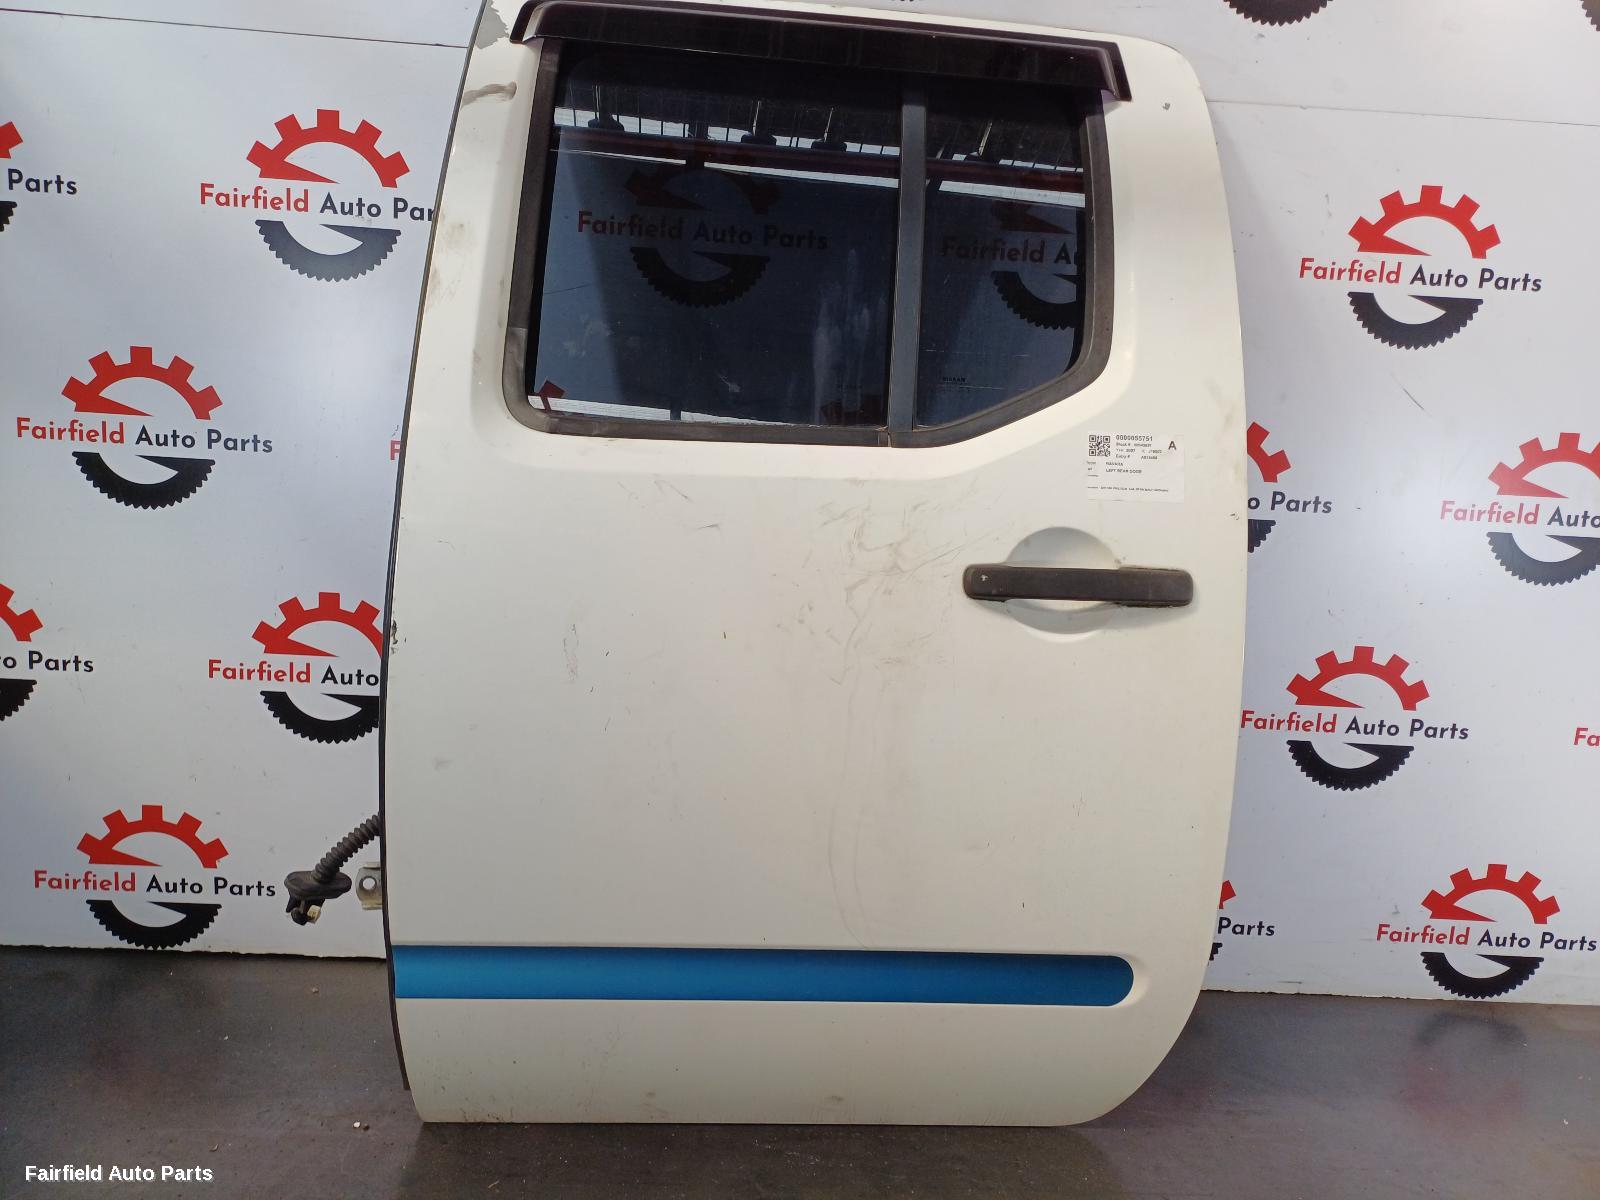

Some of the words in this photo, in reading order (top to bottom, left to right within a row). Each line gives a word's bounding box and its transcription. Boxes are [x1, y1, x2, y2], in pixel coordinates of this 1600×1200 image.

[8, 169, 77, 195] Parts
[201, 183, 309, 212] Fairfield
[320, 192, 381, 217] Auto
[393, 197, 434, 222] Par
[578, 210, 682, 241] Fairfield
[693, 217, 752, 246] Auto
[763, 224, 828, 251] Parts
[941, 236, 1045, 263] Fairfield
[1300, 258, 1401, 283] Fairfield
[1410, 264, 1468, 287] Auto
[1479, 268, 1541, 291] Parts
[17, 417, 125, 444] Fairfield
[135, 425, 195, 448] Auto
[207, 429, 272, 453] Parts
[1168, 440, 1177, 450] A
[1271, 491, 1331, 513] Parts
[1441, 501, 1540, 524] Fairfield
[1547, 506, 1600, 528] Auto
[29, 650, 93, 672] Parts
[209, 659, 311, 683] Fairfield
[321, 665, 379, 686] Auto
[1241, 710, 1337, 733] Fairfield
[1345, 716, 1399, 736] Auto
[1410, 719, 1468, 739] Parts
[35, 870, 136, 891] Fairfield
[146, 874, 203, 893] Auto
[214, 877, 275, 896] Parts
[1218, 917, 1274, 936] Parts
[1377, 924, 1470, 945] Fairfield
[1477, 929, 1530, 948] Auto
[1540, 932, 1596, 951] Parts
